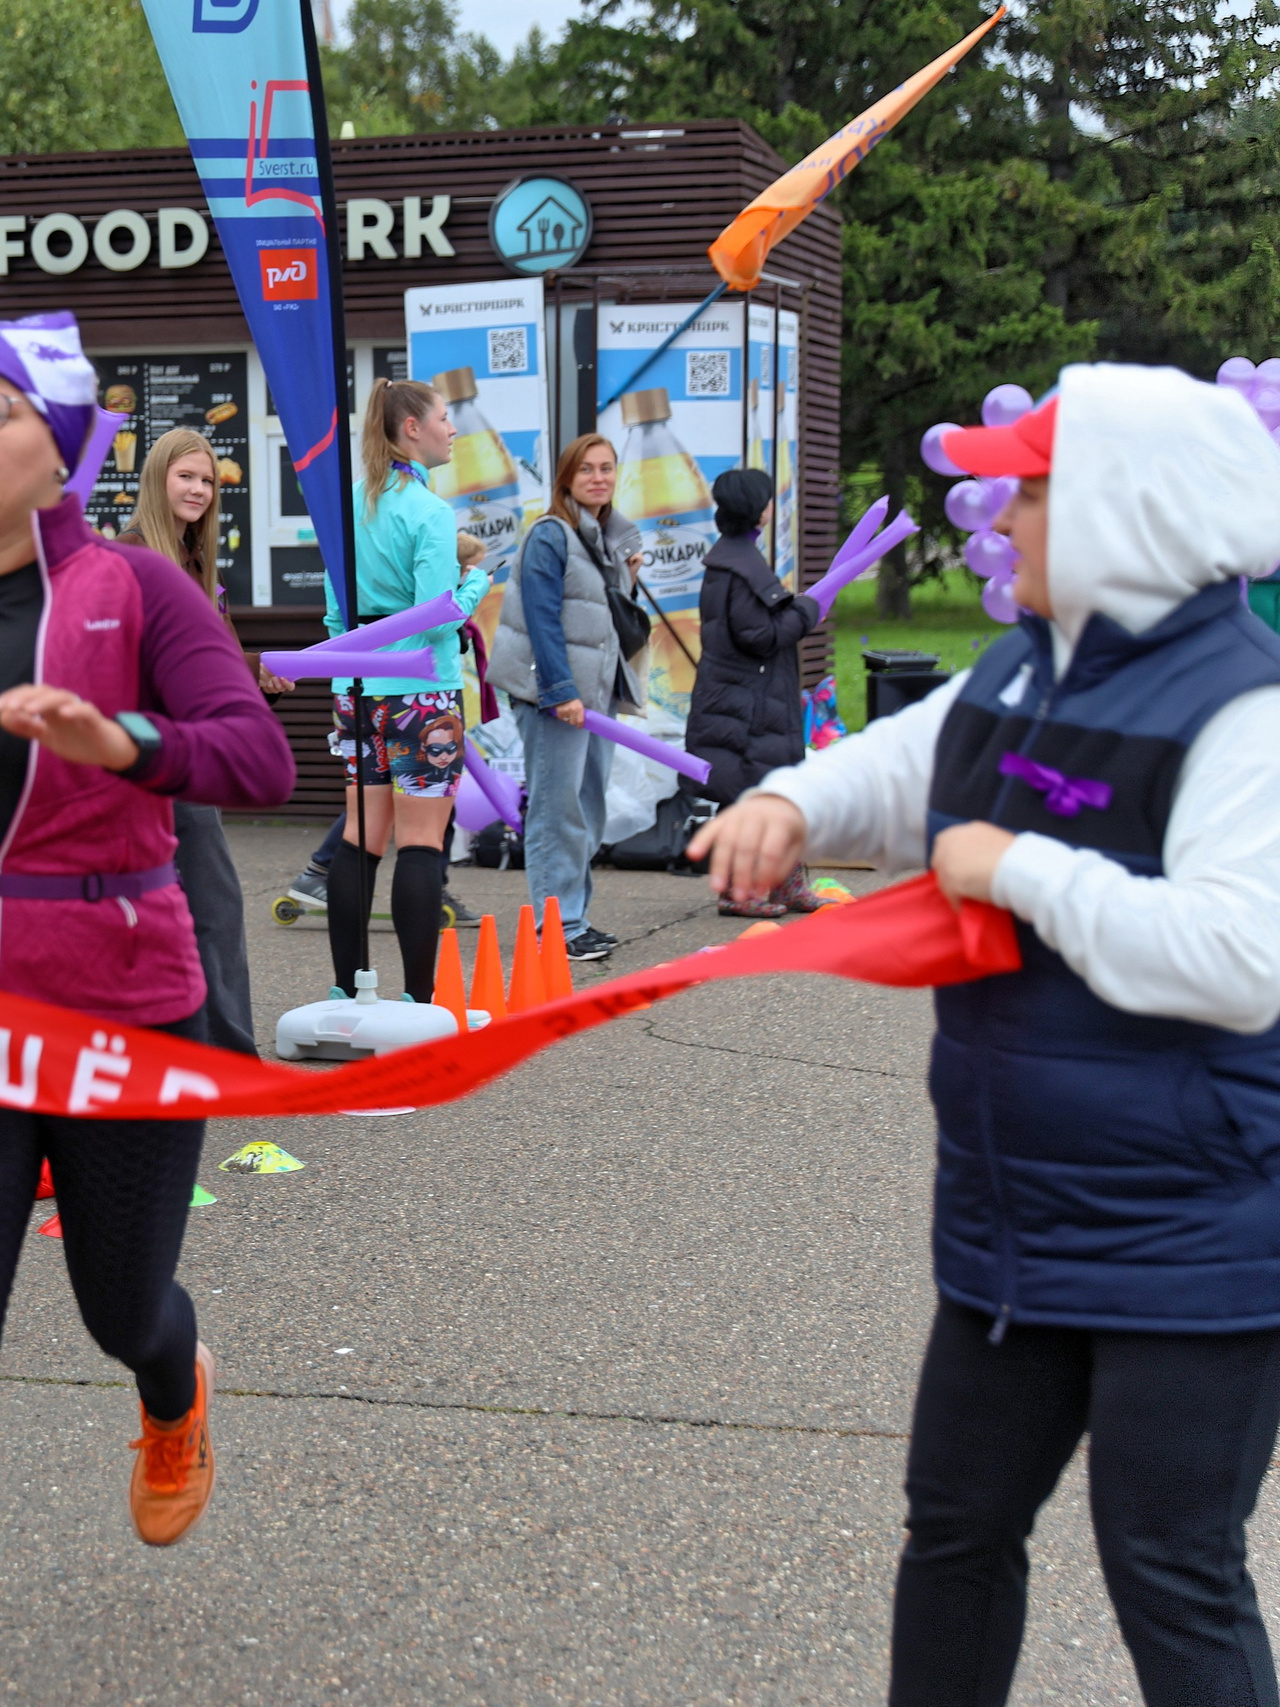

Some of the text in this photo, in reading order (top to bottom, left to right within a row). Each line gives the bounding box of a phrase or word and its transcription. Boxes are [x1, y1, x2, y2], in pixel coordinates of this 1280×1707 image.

[259, 161, 314, 176] 5verst.ru
[346, 194, 456, 262] RK
[626, 320, 730, 333] КРАСГПАРК
[457, 516, 515, 538] ЧКАРИ
[642, 541, 706, 567] ОЧКАРИ
